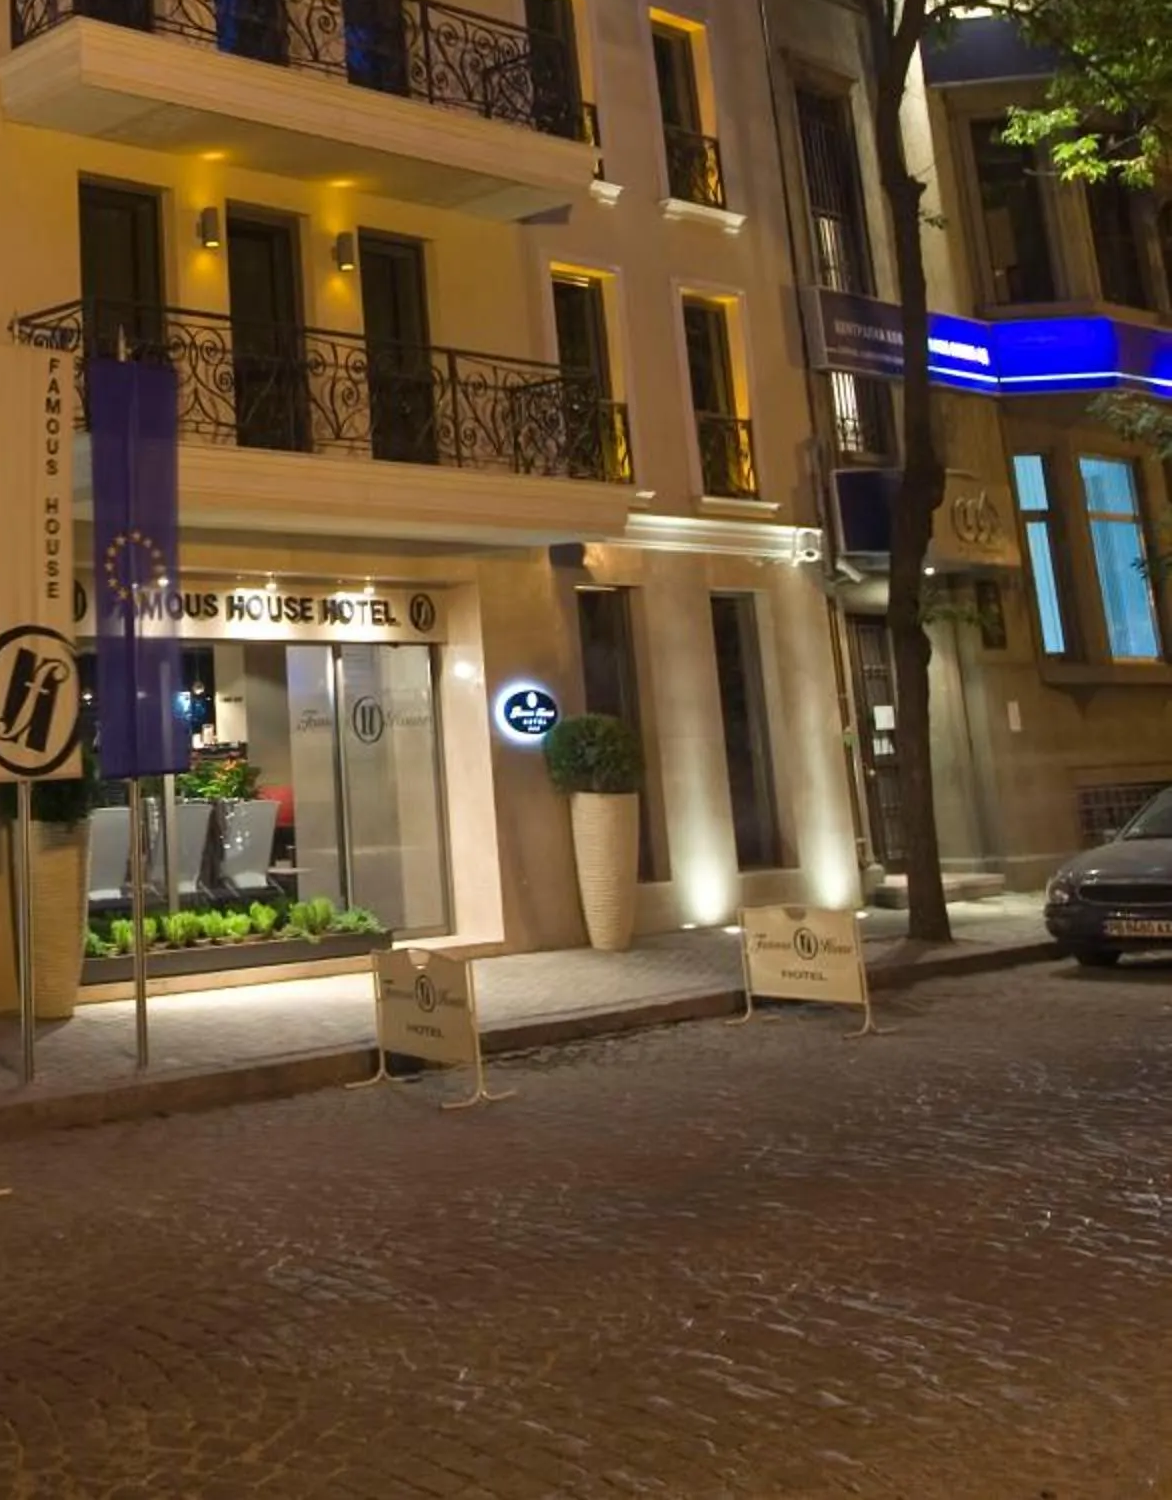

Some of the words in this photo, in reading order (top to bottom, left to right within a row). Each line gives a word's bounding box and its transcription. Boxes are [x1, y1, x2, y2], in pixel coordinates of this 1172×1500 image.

[45, 358, 61, 476] FAMOUS
[45, 498, 60, 599] HOUSE
[226, 595, 314, 621] HOUSE
[319, 599, 399, 626] HOTEL
[781, 969, 828, 981] HOTEL
